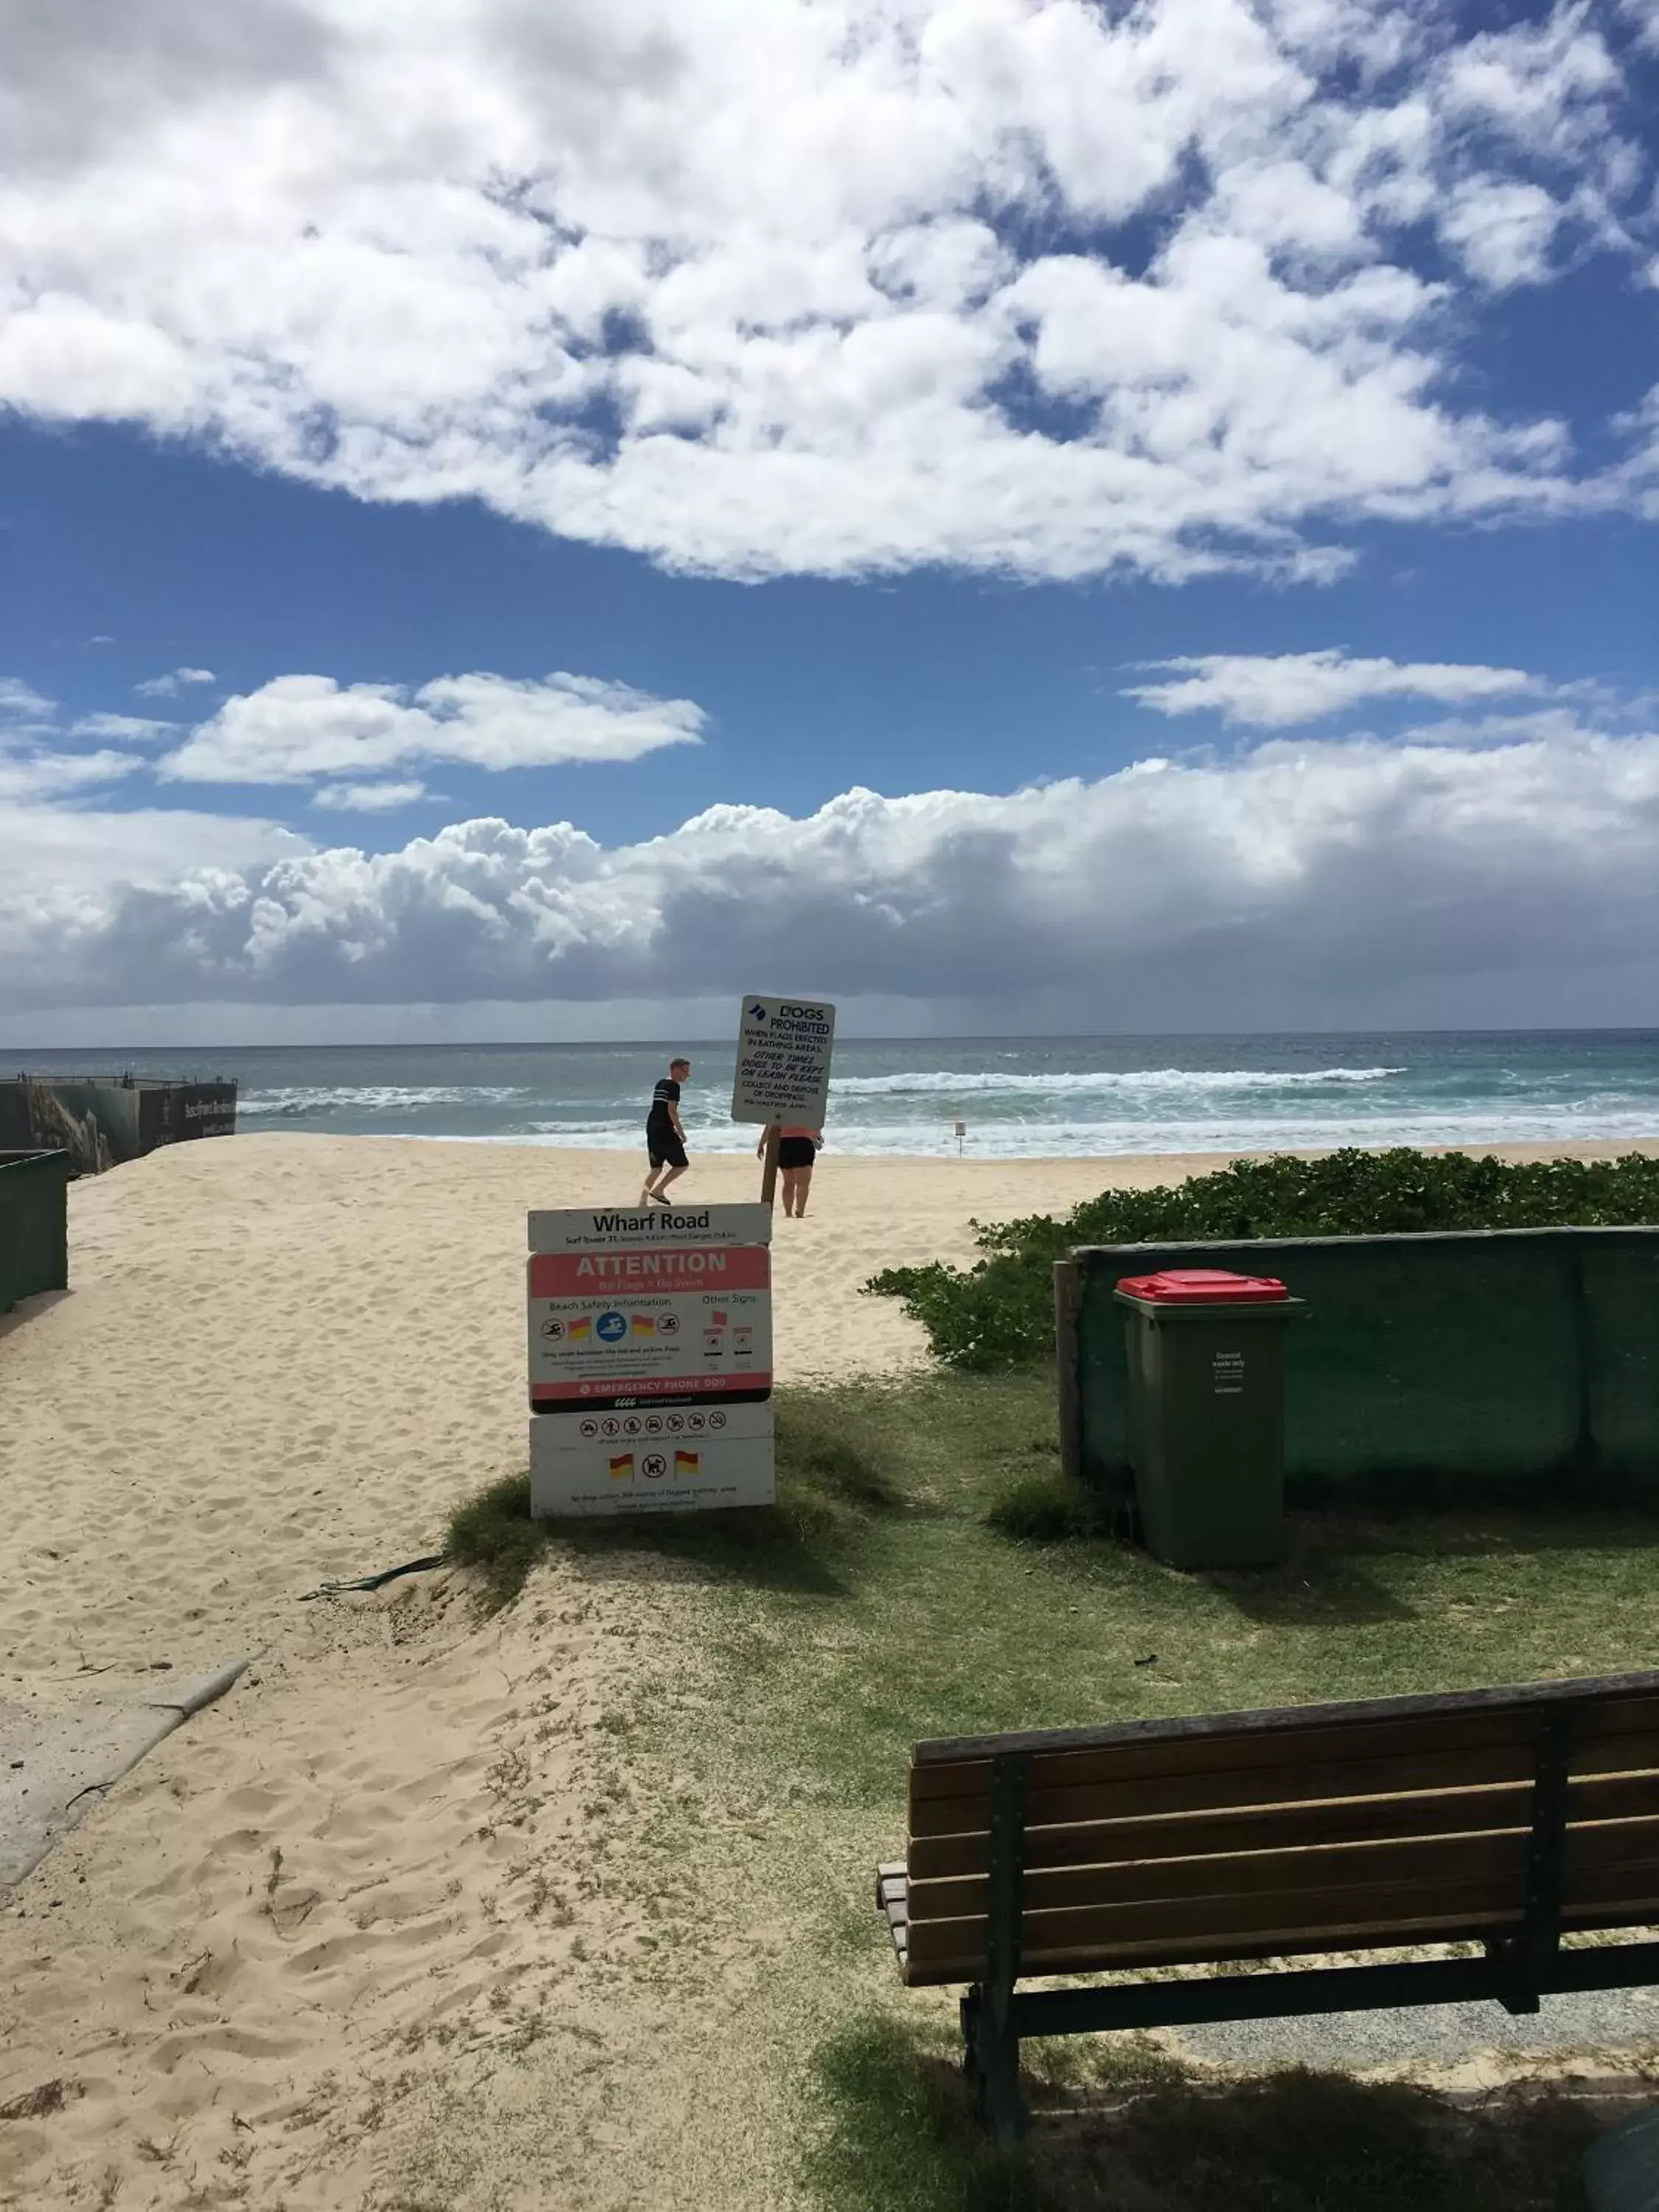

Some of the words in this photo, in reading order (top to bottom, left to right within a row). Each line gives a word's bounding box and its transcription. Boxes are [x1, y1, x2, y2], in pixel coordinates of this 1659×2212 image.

[780, 1006, 824, 1020] DOGS
[771, 1017, 830, 1034] PROHIBITED
[769, 1032, 792, 1040] FLAGS
[757, 1039, 793, 1049] BATHING
[754, 1051, 784, 1060] OTHER
[787, 1054, 814, 1064] TIMES
[742, 1059, 767, 1068] DOGS
[771, 1062, 782, 1070] TO
[758, 1071, 787, 1079] LEASH
[593, 1212, 655, 1232] Wharf
[661, 1211, 709, 1230] Road
[583, 1236, 606, 1244] Tower
[576, 1253, 727, 1277] ATTENTION
[599, 1281, 616, 1290] No
[617, 1280, 644, 1292] Flags
[657, 1279, 672, 1288] No
[675, 1277, 703, 1288] Swim
[550, 1301, 579, 1311] Beach
[581, 1300, 611, 1310] Safety
[613, 1297, 671, 1308] Information
[702, 1295, 729, 1304] Other
[731, 1293, 757, 1304] Signs
[594, 1382, 660, 1394] EMERGENCY
[664, 1380, 699, 1390] PHONE
